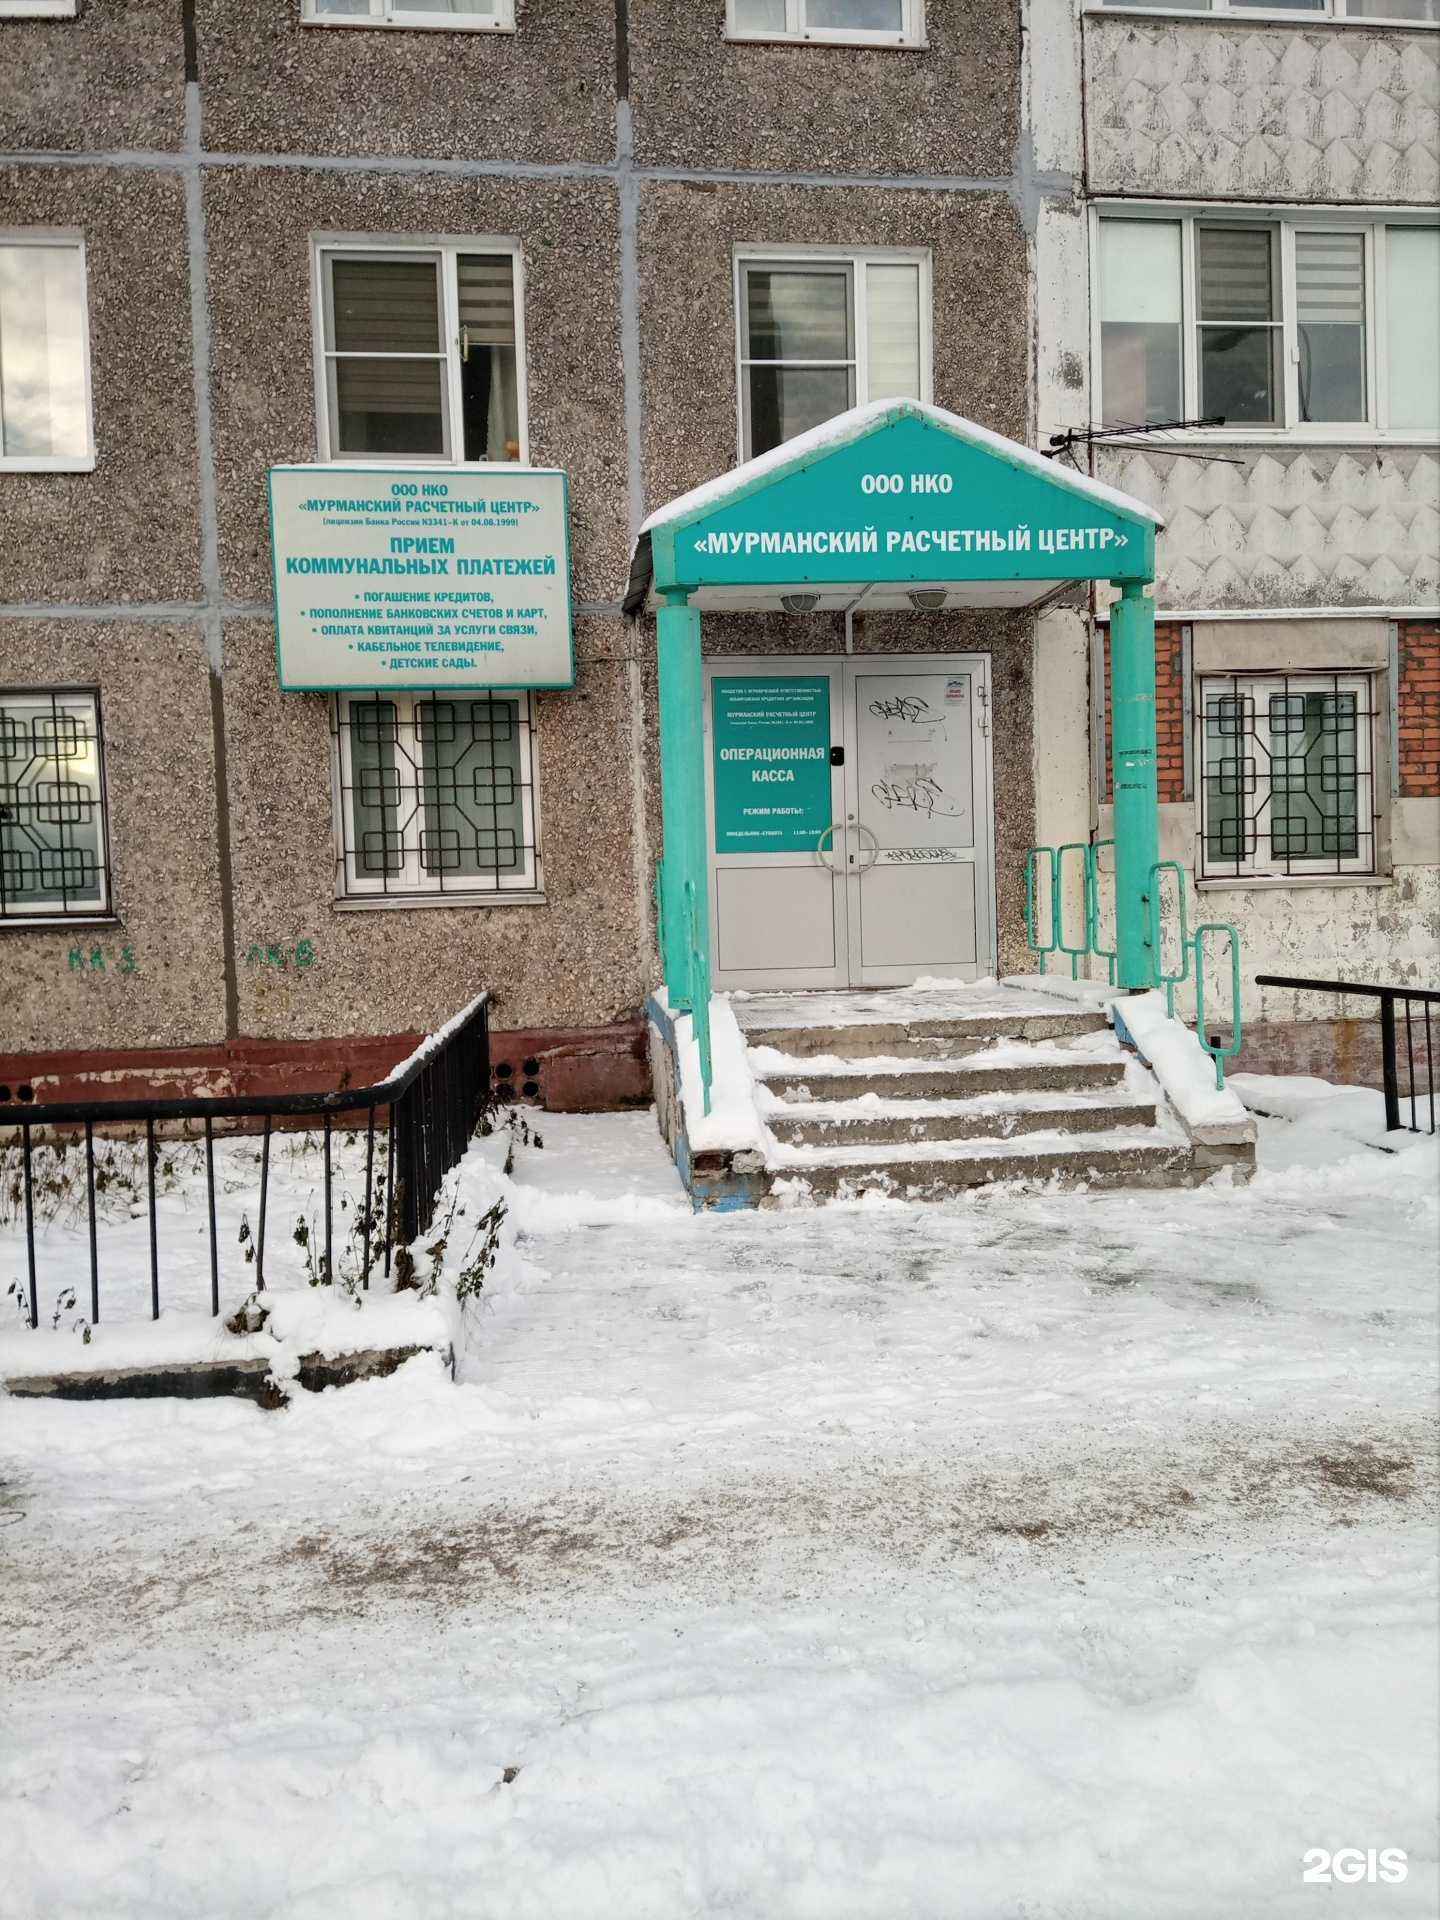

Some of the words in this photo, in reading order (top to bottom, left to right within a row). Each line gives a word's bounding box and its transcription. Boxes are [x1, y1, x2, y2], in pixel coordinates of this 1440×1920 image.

[391, 484, 418, 496] ООО
[422, 484, 448, 496] НКО
[861, 474, 904, 494] ООО
[911, 473, 953, 494] НКО
[298, 498, 401, 513] «МУРМАНСКИЙ
[406, 499, 486, 513] РАСЧЕТНЫЙ
[490, 501, 540, 515] ЦЕНТР»
[365, 518, 389, 526] Банка
[391, 518, 420, 526] России
[390, 537, 455, 554] ПРИЕМ
[693, 525, 879, 554] «МУРМАНСКИЙ
[887, 524, 1031, 553] РАСЧЕТНЫЙ
[1038, 527, 1129, 554] ЦЕНТР»
[286, 557, 449, 575] КОММУНАЛЬНЫХ
[457, 555, 556, 575] ПЛАТЕЖЕЙ
[364, 592, 431, 602] ПОГАШЕНИЕ
[434, 592, 494, 603] КРЕДИТОВ,
[310, 608, 383, 619] ПОПОЛНЕНИЕ
[386, 608, 459, 619] БАНКОВСКИХ
[462, 608, 503, 619] СЧЕТОВ
[506, 608, 514, 619] И
[517, 608, 548, 620] КАРТ,
[321, 625, 364, 636] ОПЛАТА
[367, 624, 434, 637] КВИТАНЦИЙ
[437, 625, 451, 635] ЗА
[454, 625, 496, 635] УСЛУГИ
[499, 625, 538, 636] СВЯЗИ,
[357, 642, 422, 652] КАБЕЛЬНОЕ
[424, 641, 505, 653] ТЕЛЕВИДЕНИЕ,
[390, 658, 439, 670] ДЕТСКИЕ
[442, 658, 478, 669] САДЫ.
[720, 747, 825, 762] ОПЕРАЦИОННАЯ
[752, 769, 795, 782] КАССА
